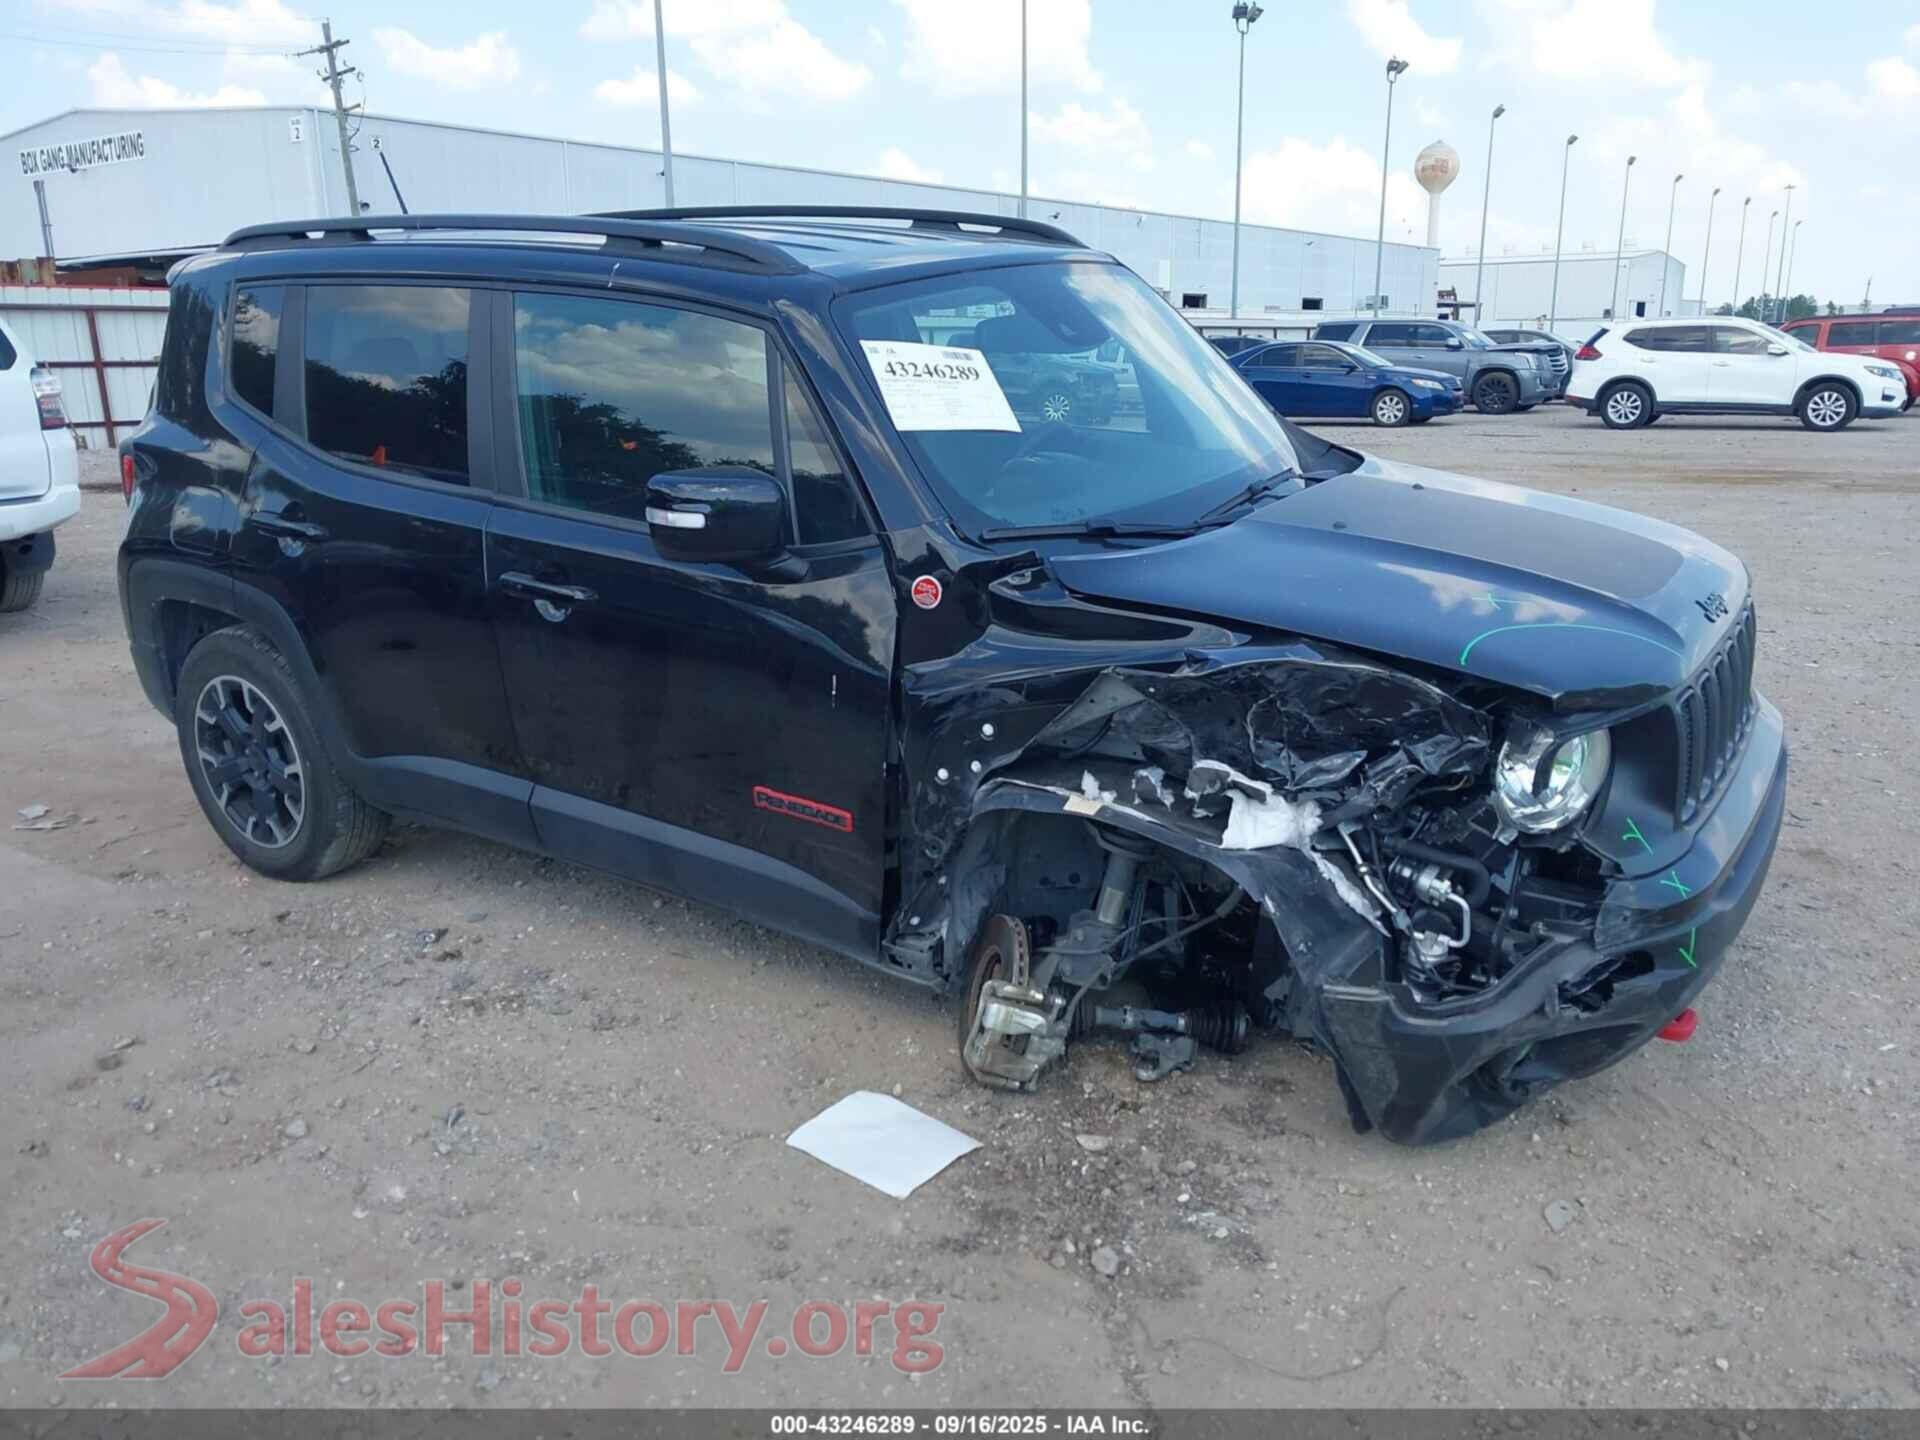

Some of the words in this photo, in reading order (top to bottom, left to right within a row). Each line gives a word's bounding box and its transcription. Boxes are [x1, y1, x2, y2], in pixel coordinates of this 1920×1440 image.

[20, 152, 39, 174] BOX
[40, 148, 65, 171] GANG
[65, 132, 144, 168] MANUFACTURING
[373, 139, 380, 149] 2
[884, 360, 980, 381] 43246289
